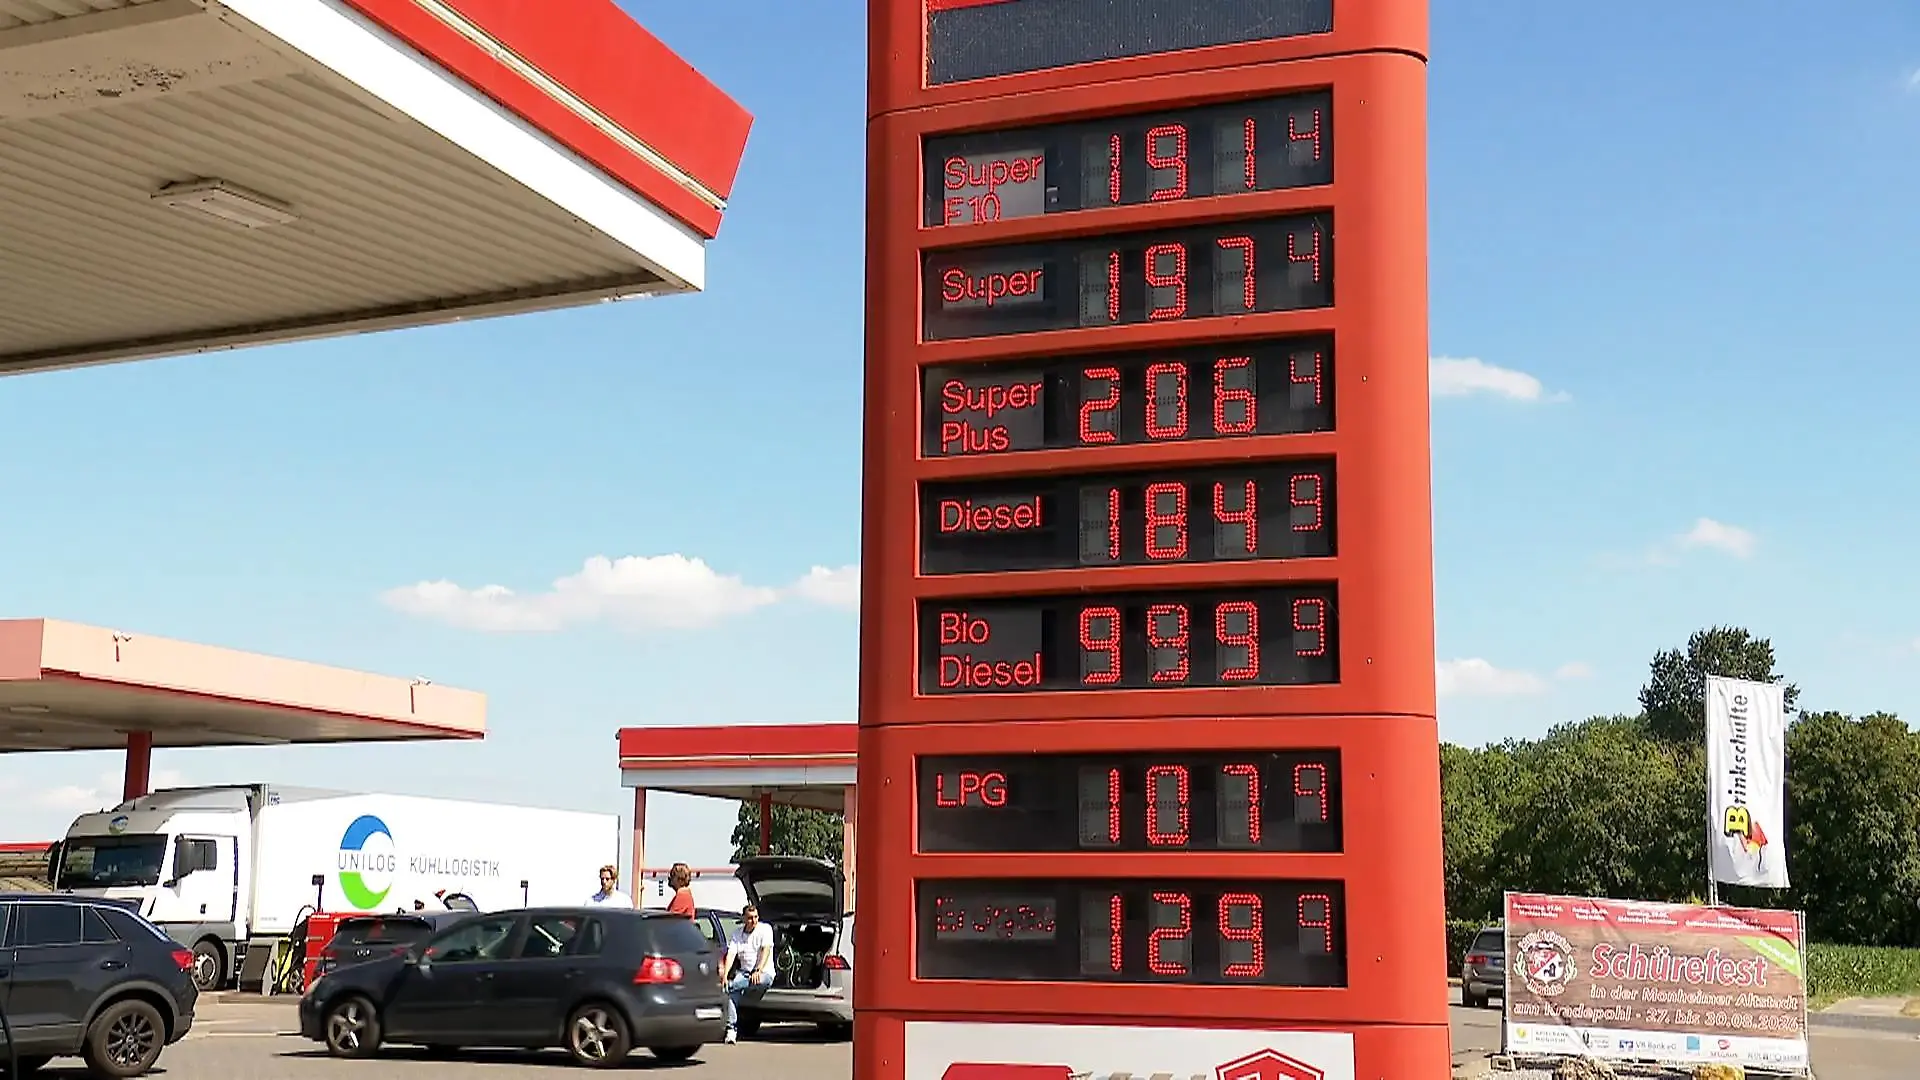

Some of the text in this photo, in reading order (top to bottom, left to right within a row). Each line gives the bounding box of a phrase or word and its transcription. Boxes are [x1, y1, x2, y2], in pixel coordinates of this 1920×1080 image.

[944, 155, 1043, 192] Super
[942, 268, 1042, 306] Super
[942, 380, 1042, 418] Super
[942, 422, 1010, 453] Plus
[940, 496, 1041, 533] Diesel
[940, 612, 990, 645] Bio
[939, 652, 1041, 688] Diesel
[1724, 694, 1752, 839] Brinkschulte
[936, 773, 1008, 807] LPG
[338, 853, 500, 877] UNILOG KÜHLLOGISTIK
[1590, 943, 1767, 987] Schürefest
[1513, 1002, 1540, 1015] am
[1675, 1009, 1700, 1025] bis
[1610, 985, 1638, 1000] der
[1642, 987, 1733, 1006] Monheimer
[1735, 992, 1798, 1010] Altstadt
